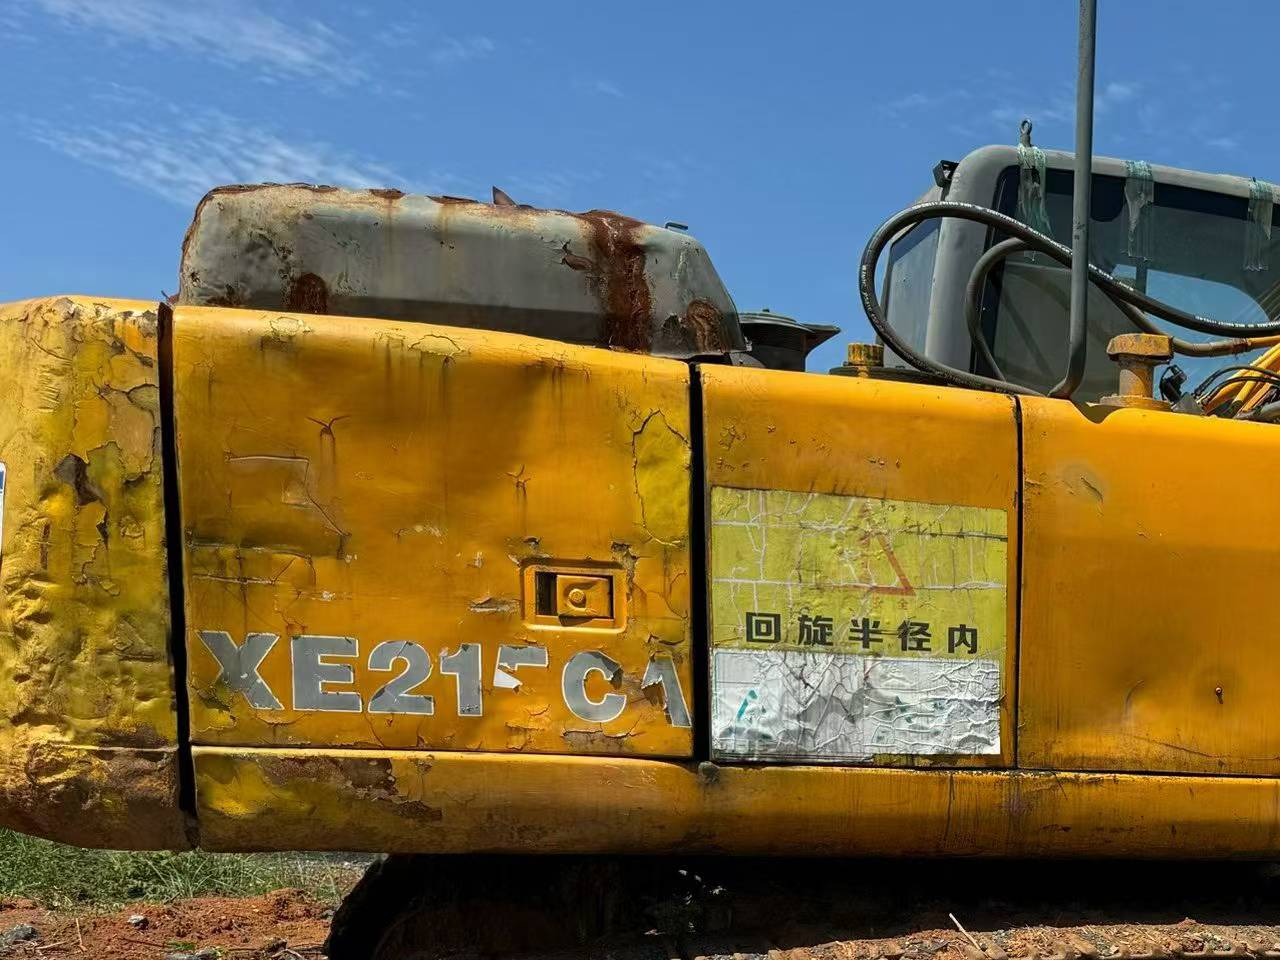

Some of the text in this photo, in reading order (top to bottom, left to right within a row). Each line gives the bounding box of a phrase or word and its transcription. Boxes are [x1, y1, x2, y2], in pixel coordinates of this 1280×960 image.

[745, 611, 978, 654] 回旋半径内
